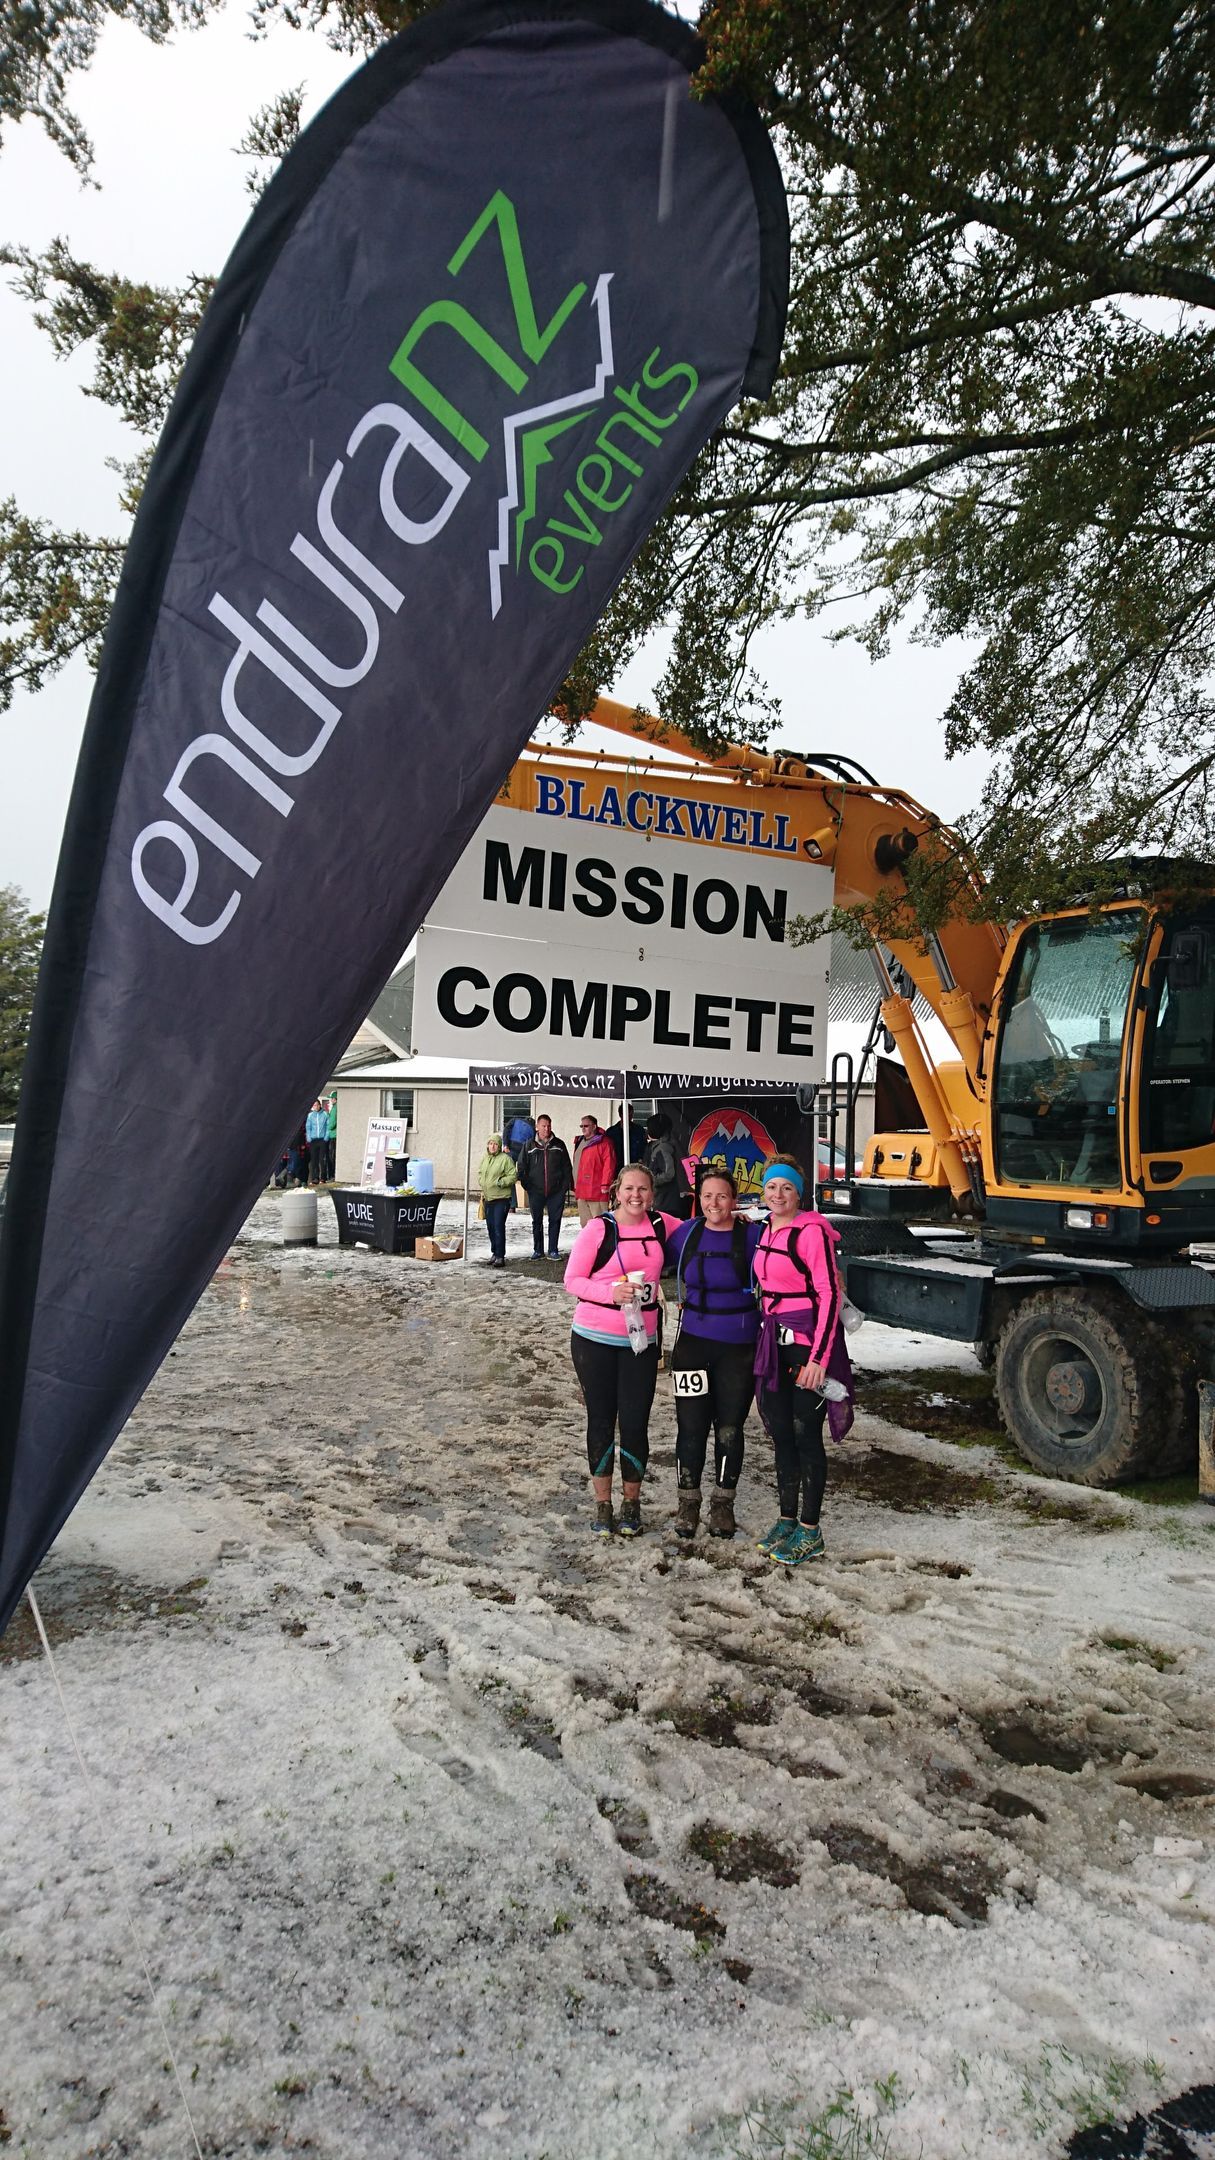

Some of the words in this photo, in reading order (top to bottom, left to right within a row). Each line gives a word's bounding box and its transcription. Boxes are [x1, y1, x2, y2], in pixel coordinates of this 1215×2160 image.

[529, 346, 700, 596] events
[131, 190, 588, 945] enduranz
[534, 773, 799, 854] BLACKWELL
[482, 839, 788, 943] MISSION
[437, 966, 815, 1057] COMPLETE
[474, 1069, 616, 1090] www.bigals.co.nz
[370, 1122, 401, 1132] Massage
[346, 1202, 374, 1222] PURE
[397, 1206, 435, 1222] PURE
[673, 1372, 704, 1394] 149
